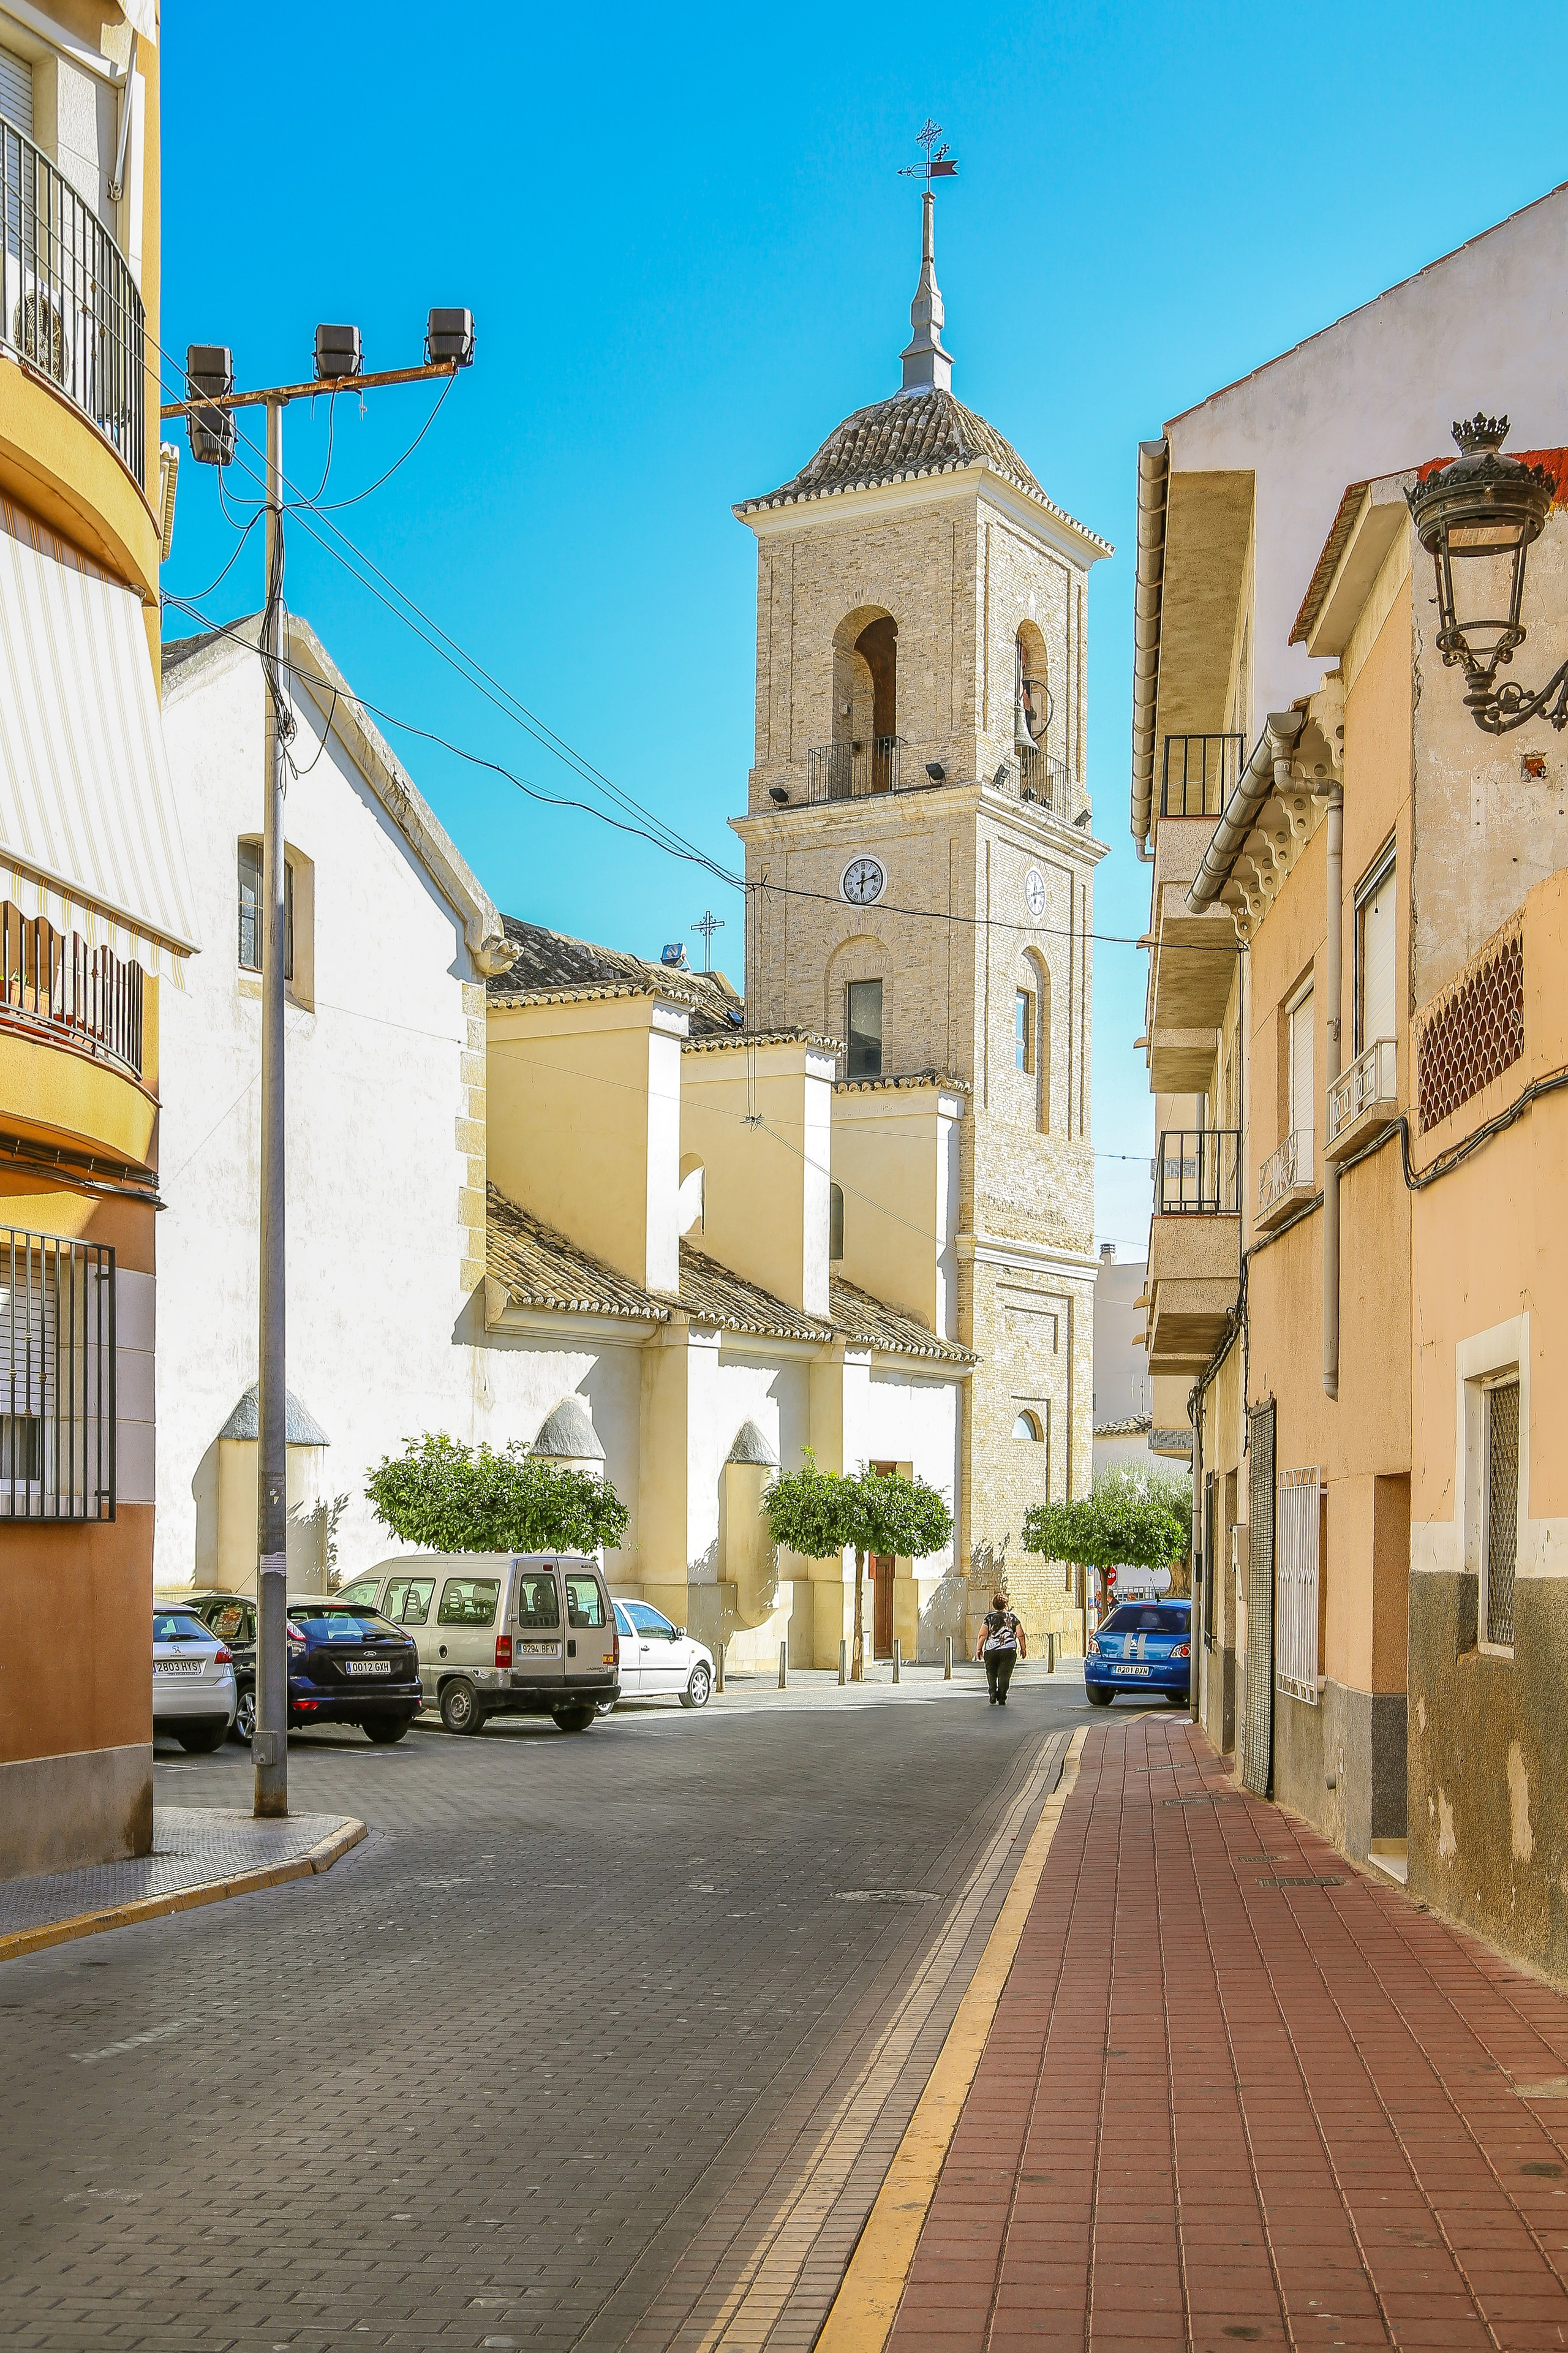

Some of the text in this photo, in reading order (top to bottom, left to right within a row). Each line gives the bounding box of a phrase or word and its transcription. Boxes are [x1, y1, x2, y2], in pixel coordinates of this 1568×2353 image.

[157, 1661, 198, 1672] 2803 HYS
[352, 1663, 389, 1672] 0012 GXH
